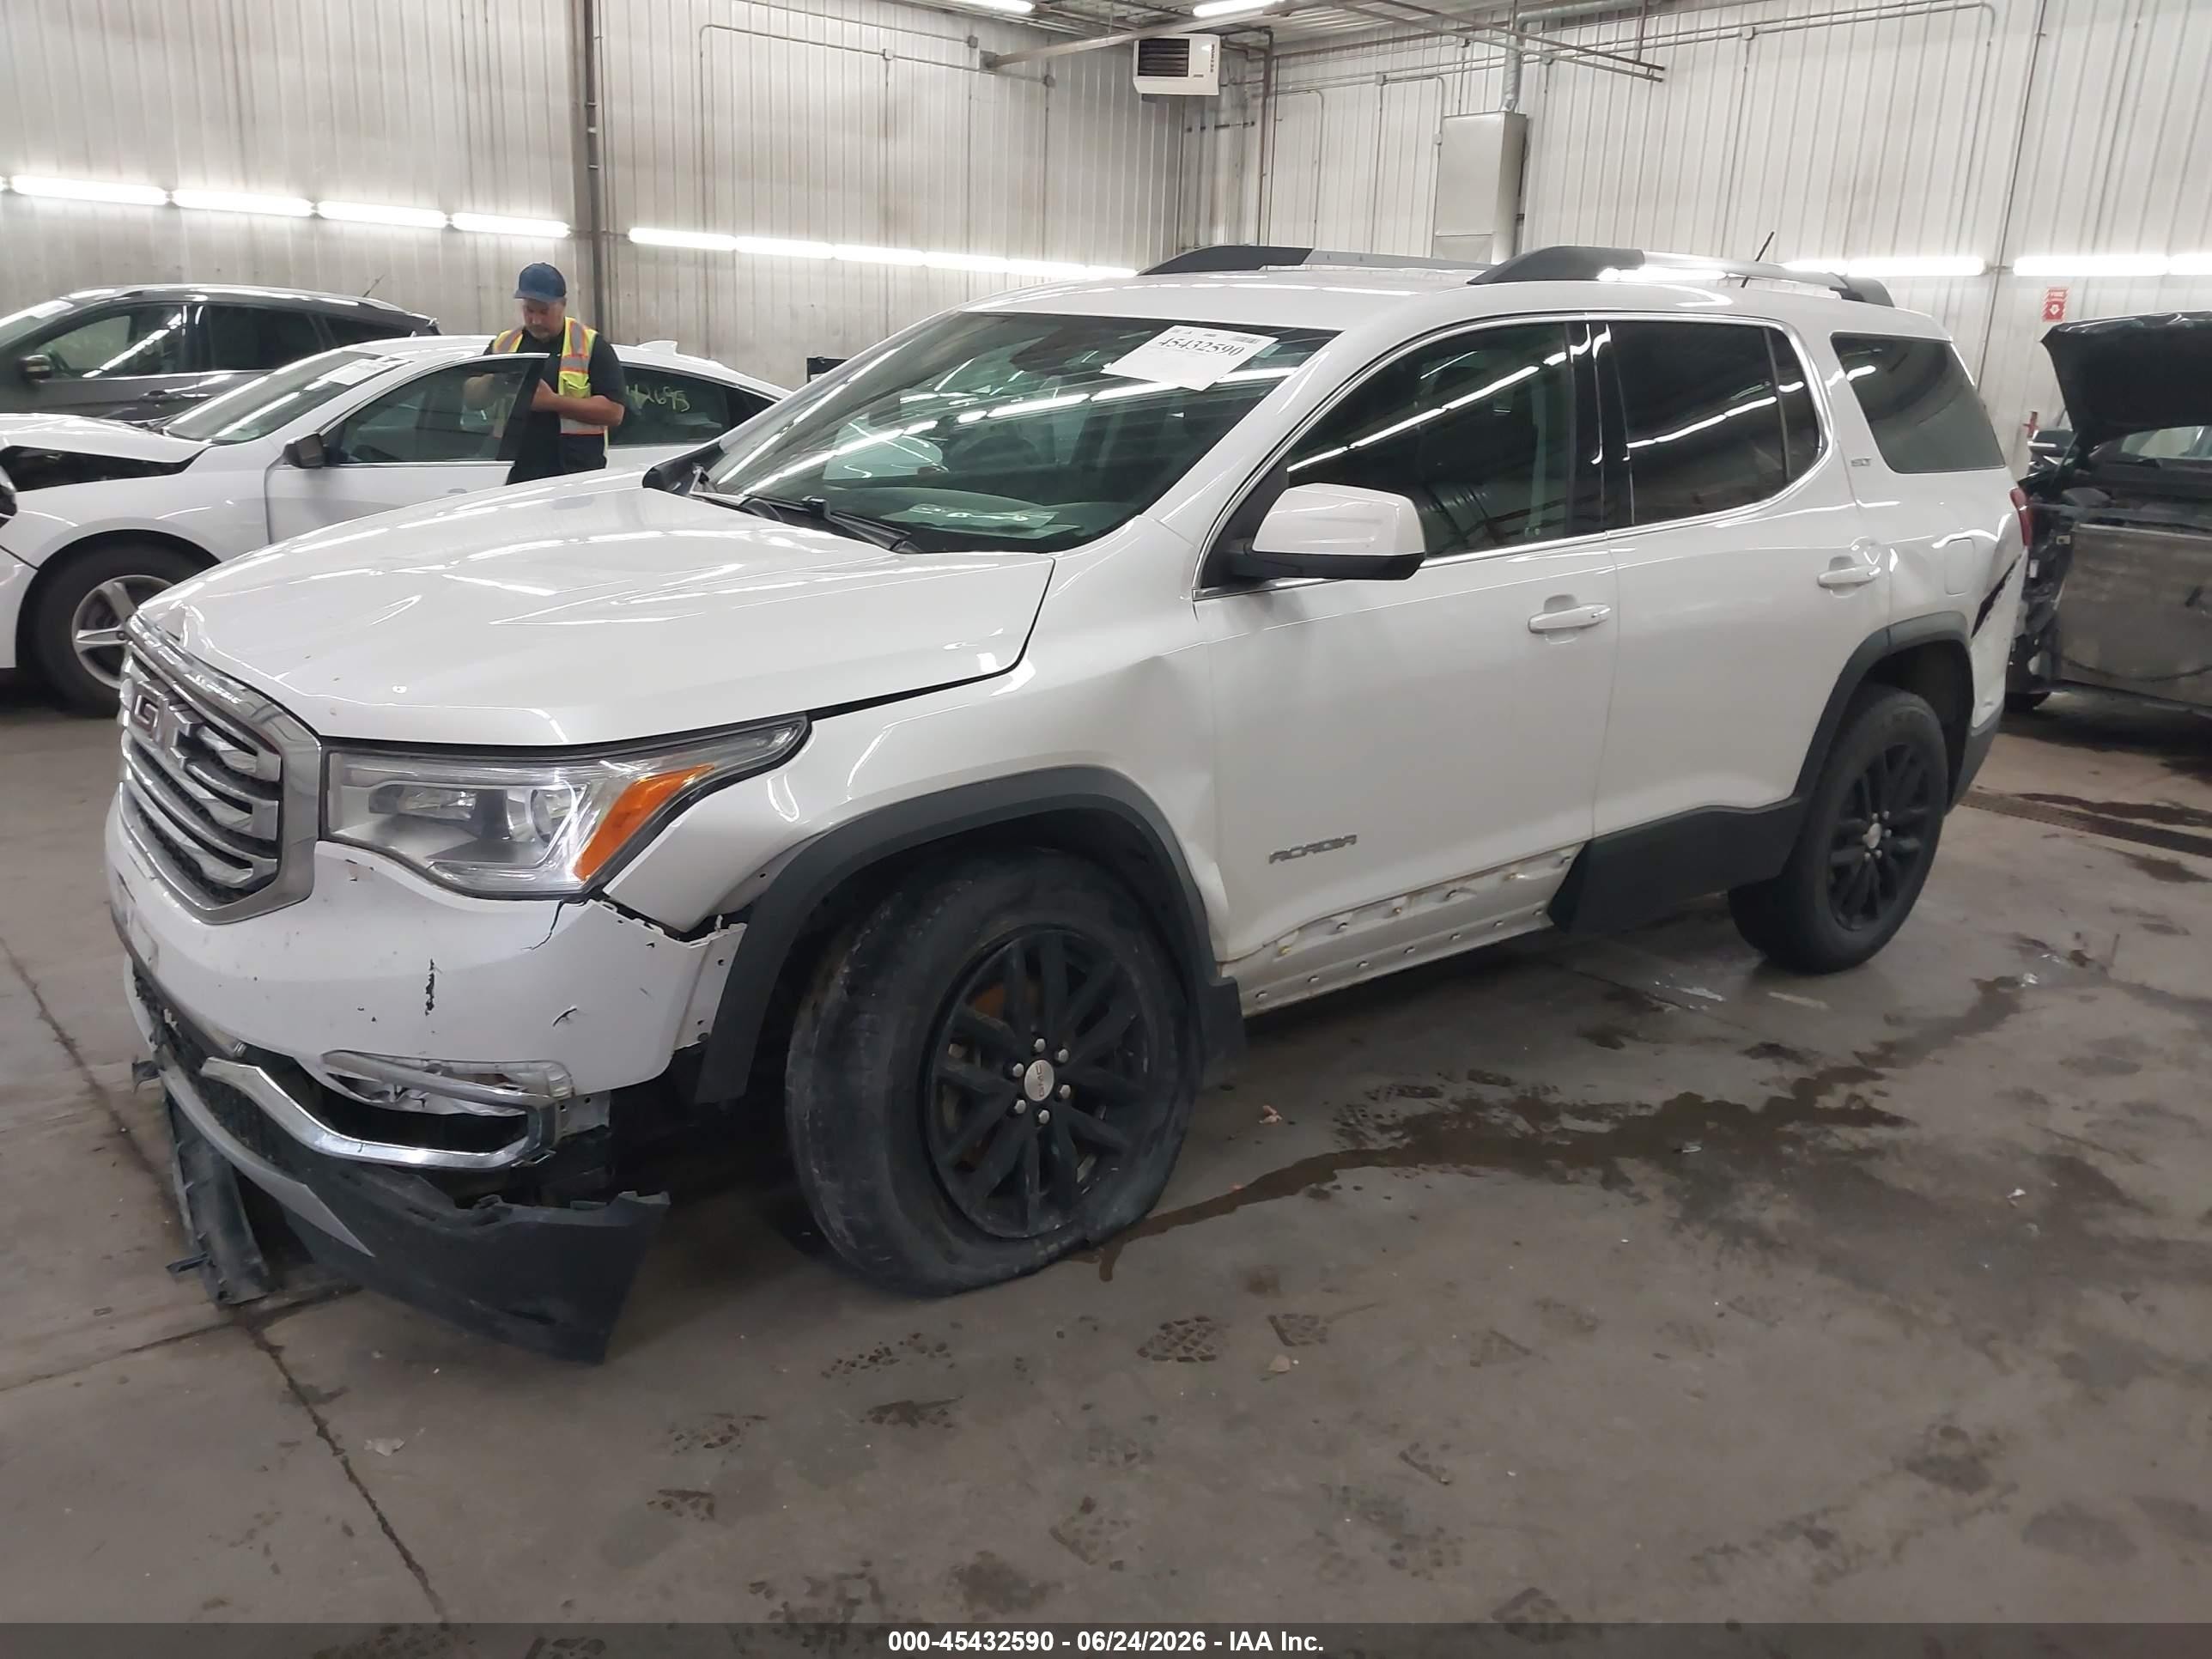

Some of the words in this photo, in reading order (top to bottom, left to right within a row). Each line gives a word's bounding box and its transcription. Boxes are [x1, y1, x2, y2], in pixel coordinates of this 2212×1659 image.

[1158, 337, 1245, 357] 45432590
[1268, 834, 1358, 864] ACADIA
[1036, 1064, 1045, 1097] GMC
